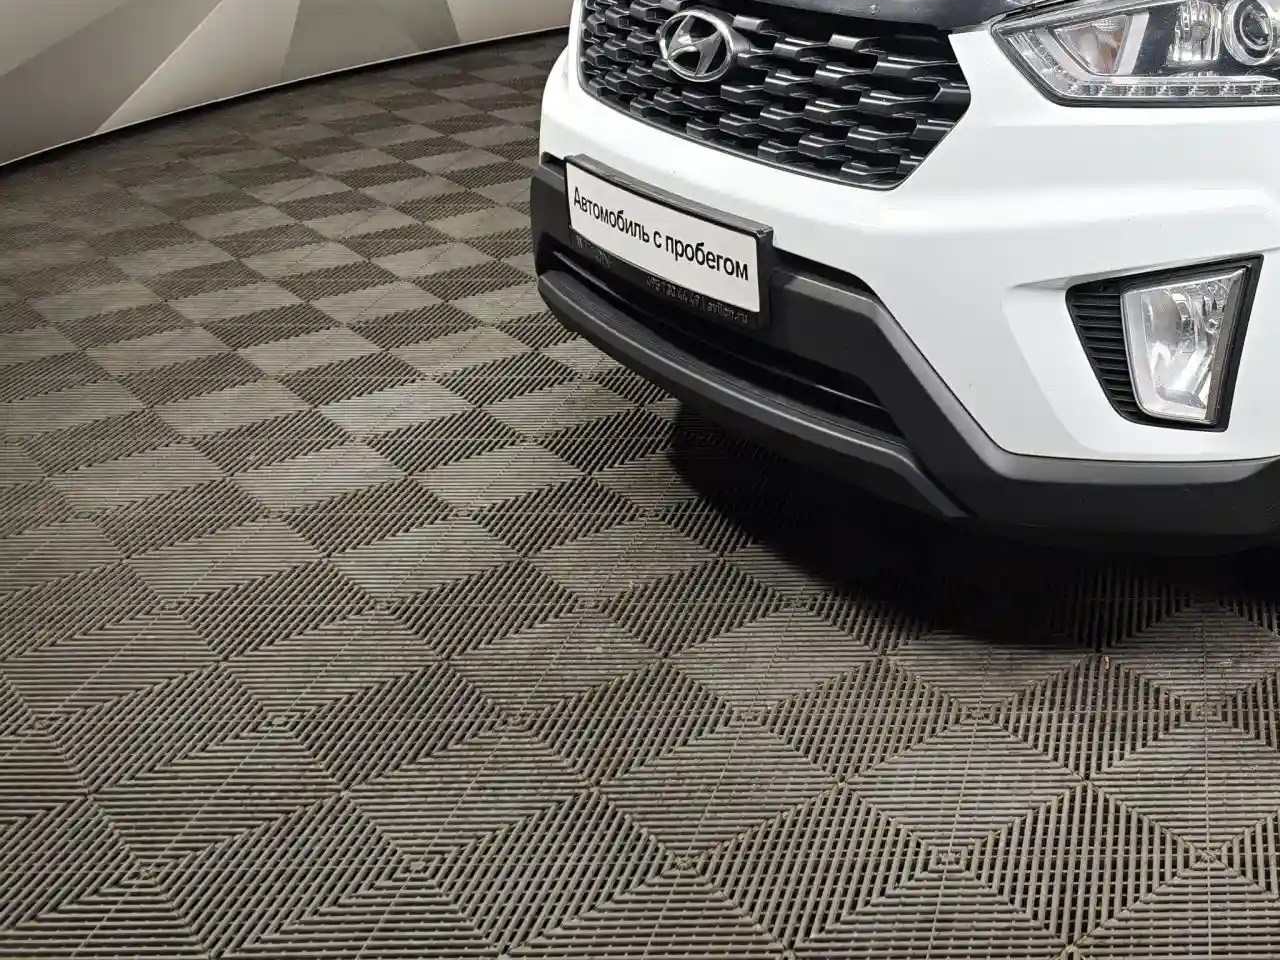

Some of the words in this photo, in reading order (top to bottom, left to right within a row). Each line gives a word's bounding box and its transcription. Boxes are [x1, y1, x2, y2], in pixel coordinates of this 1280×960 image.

[573, 186, 651, 243] Автомобиль
[653, 231, 662, 248] с
[665, 235, 749, 281] пробегом
